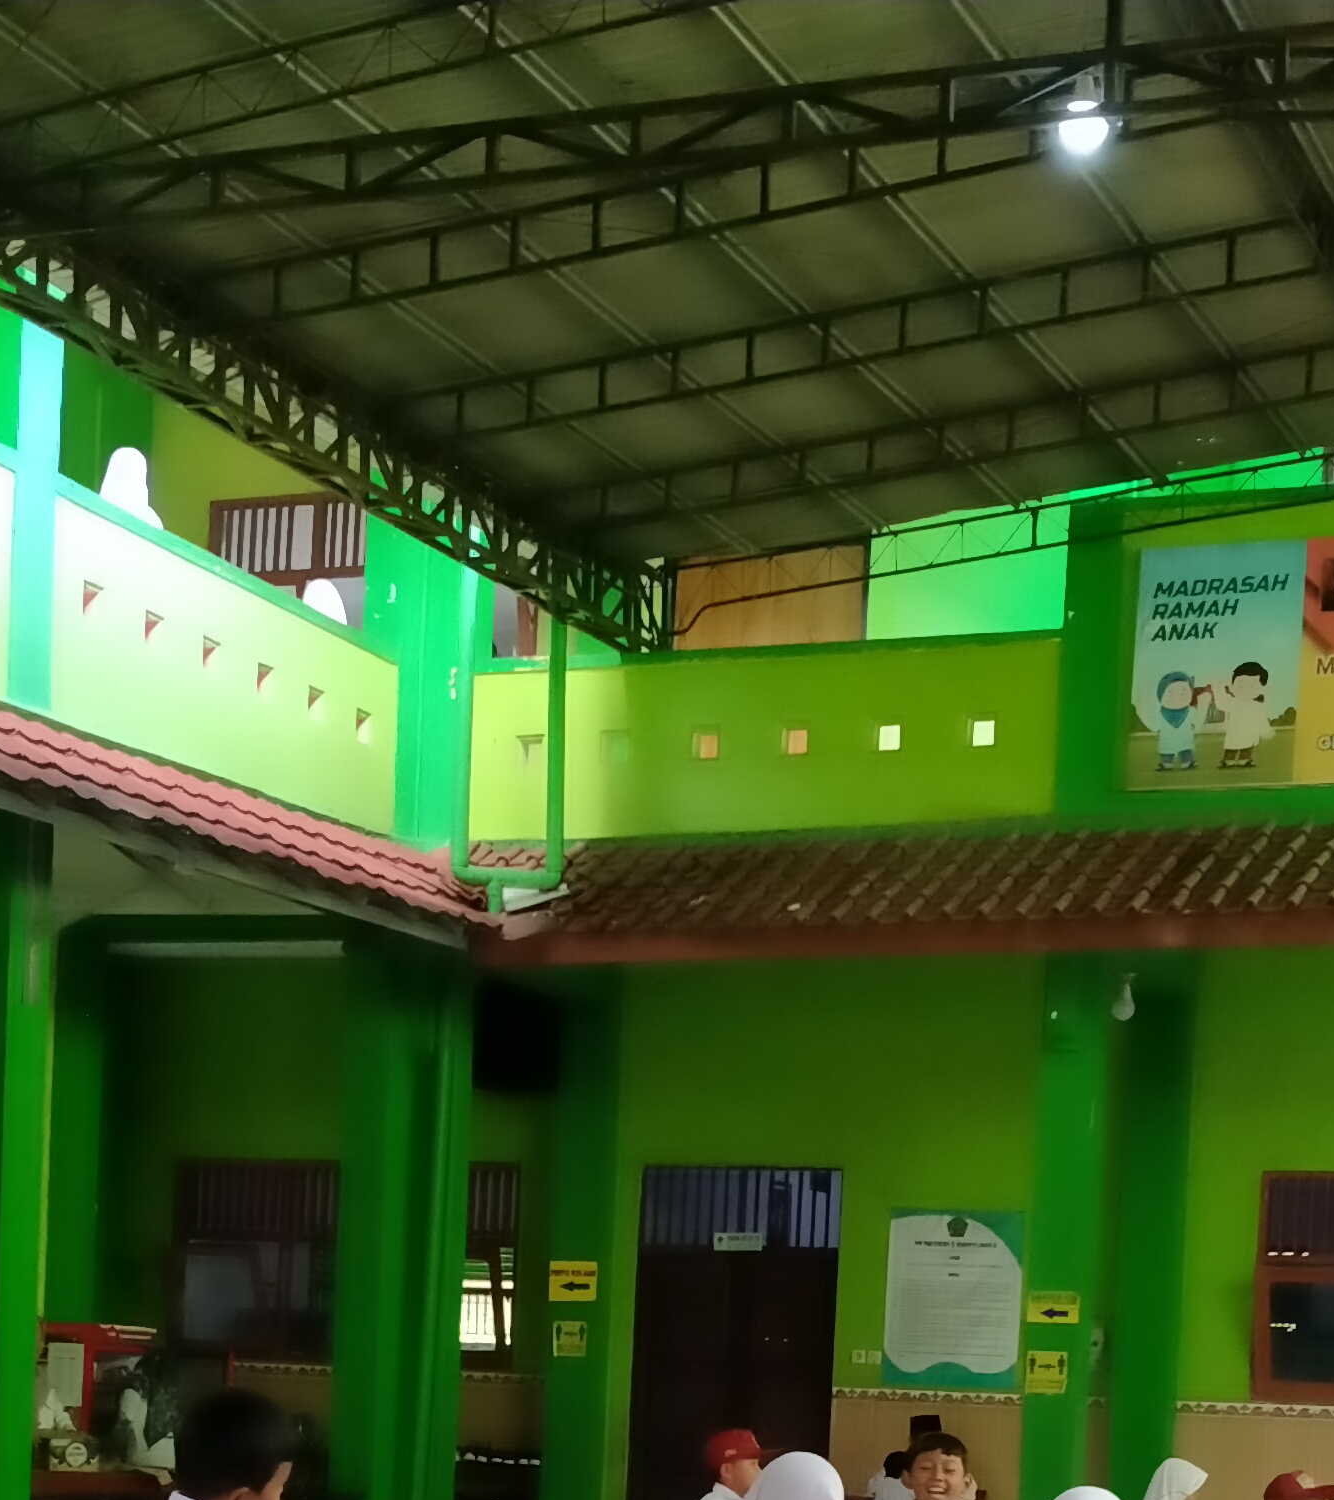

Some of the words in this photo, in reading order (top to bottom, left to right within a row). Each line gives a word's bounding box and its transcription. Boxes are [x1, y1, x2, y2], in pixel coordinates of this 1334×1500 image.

[1153, 573, 1290, 598] MADRASAH
[1152, 599, 1240, 620] RAMAH
[1151, 622, 1219, 641] ANAK
